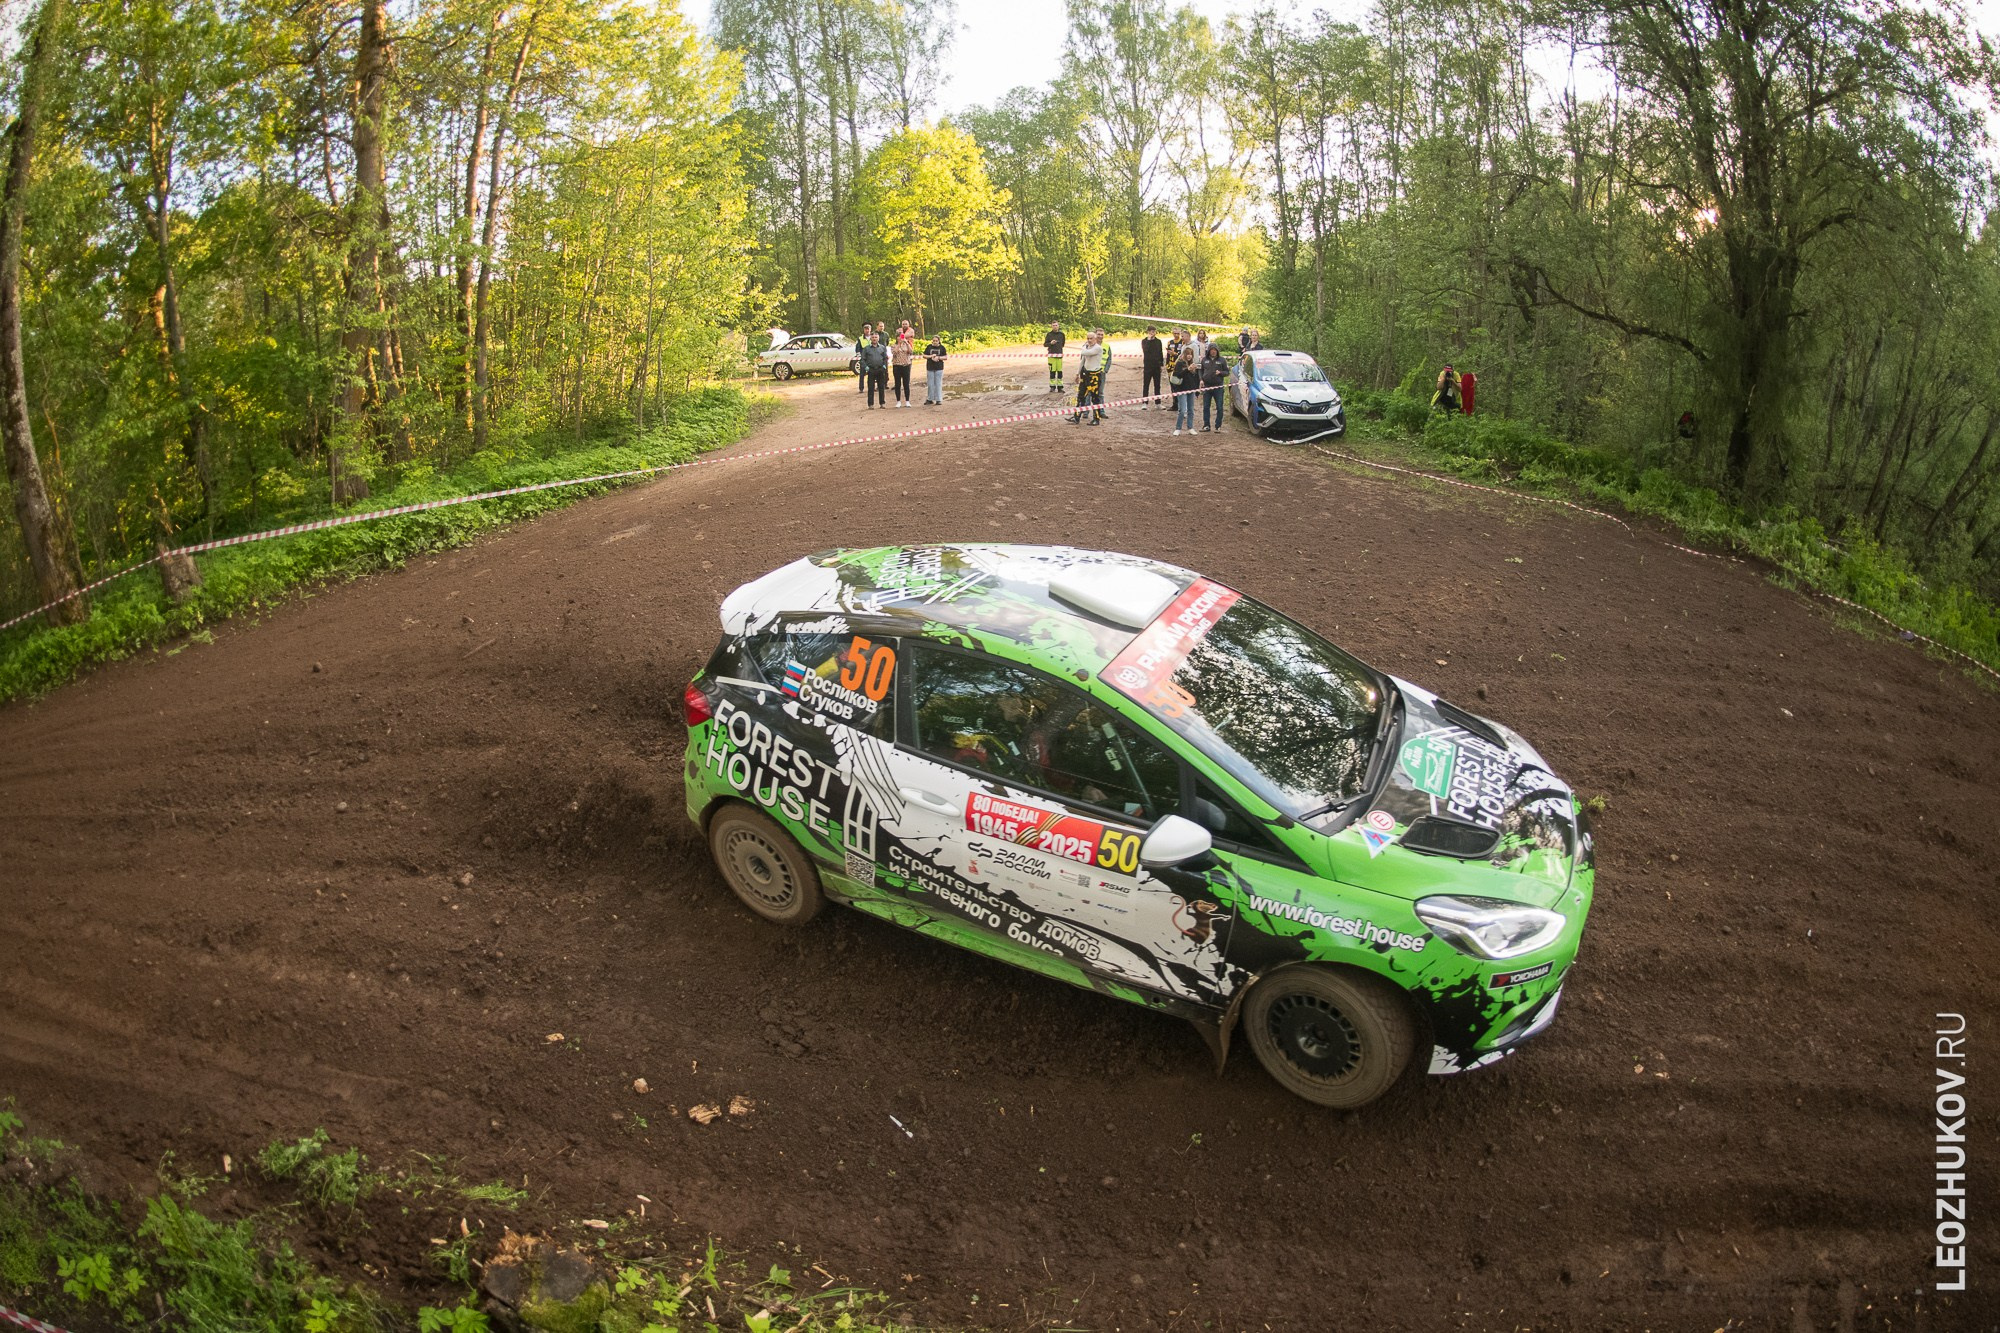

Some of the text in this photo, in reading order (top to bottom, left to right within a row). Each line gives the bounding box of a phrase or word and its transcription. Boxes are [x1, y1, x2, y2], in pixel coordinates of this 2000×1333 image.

[876, 551, 912, 589] HOUSE
[1136, 588, 1223, 671] РАЛЛИ РОССИИ
[803, 667, 878, 714] Росликов
[840, 635, 896, 702] 50
[799, 685, 854, 720] Стуков
[1146, 679, 1197, 718] 50
[714, 699, 841, 799] FOREST
[1427, 736, 1452, 756] 50
[706, 734, 831, 836] HOUSE
[1447, 746, 1482, 820] FOREST
[1475, 757, 1509, 829] HOUSE
[972, 794, 1040, 824] 80 ПОБЕДА!
[971, 813, 1095, 864] 1945 2025
[996, 848, 1046, 869] РАЛЛИ
[1097, 829, 1142, 873] 50
[993, 857, 1051, 880] РОССИИ
[888, 861, 910, 880] из
[917, 876, 1001, 928] клееного
[888, 845, 1101, 961] Строительство домов
[1249, 894, 1427, 952] www.forest.house
[1509, 964, 1550, 984] YOKOHAMA
